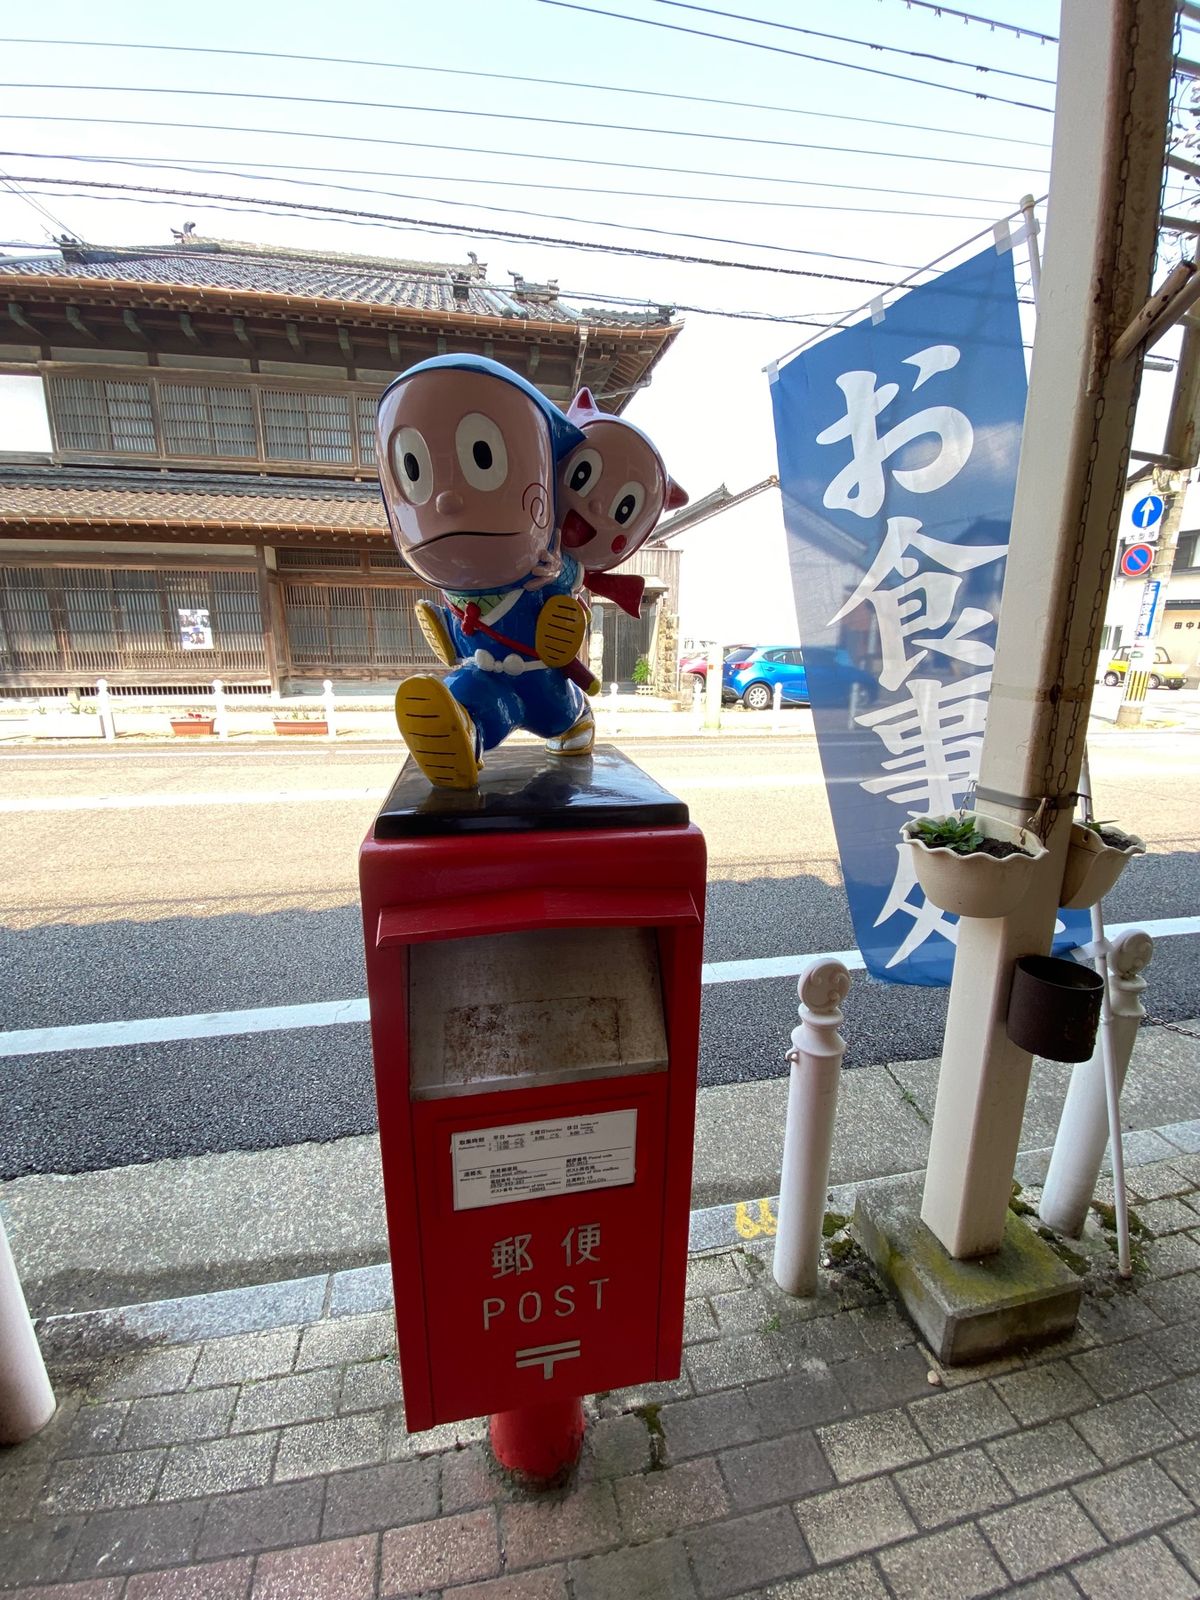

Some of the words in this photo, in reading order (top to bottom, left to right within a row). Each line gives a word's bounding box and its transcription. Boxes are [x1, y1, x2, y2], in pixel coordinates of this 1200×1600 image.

[1174, 621, 1200, 630] 田中
[490, 1222, 602, 1279] 郵便
[482, 1277, 610, 1331] POST
